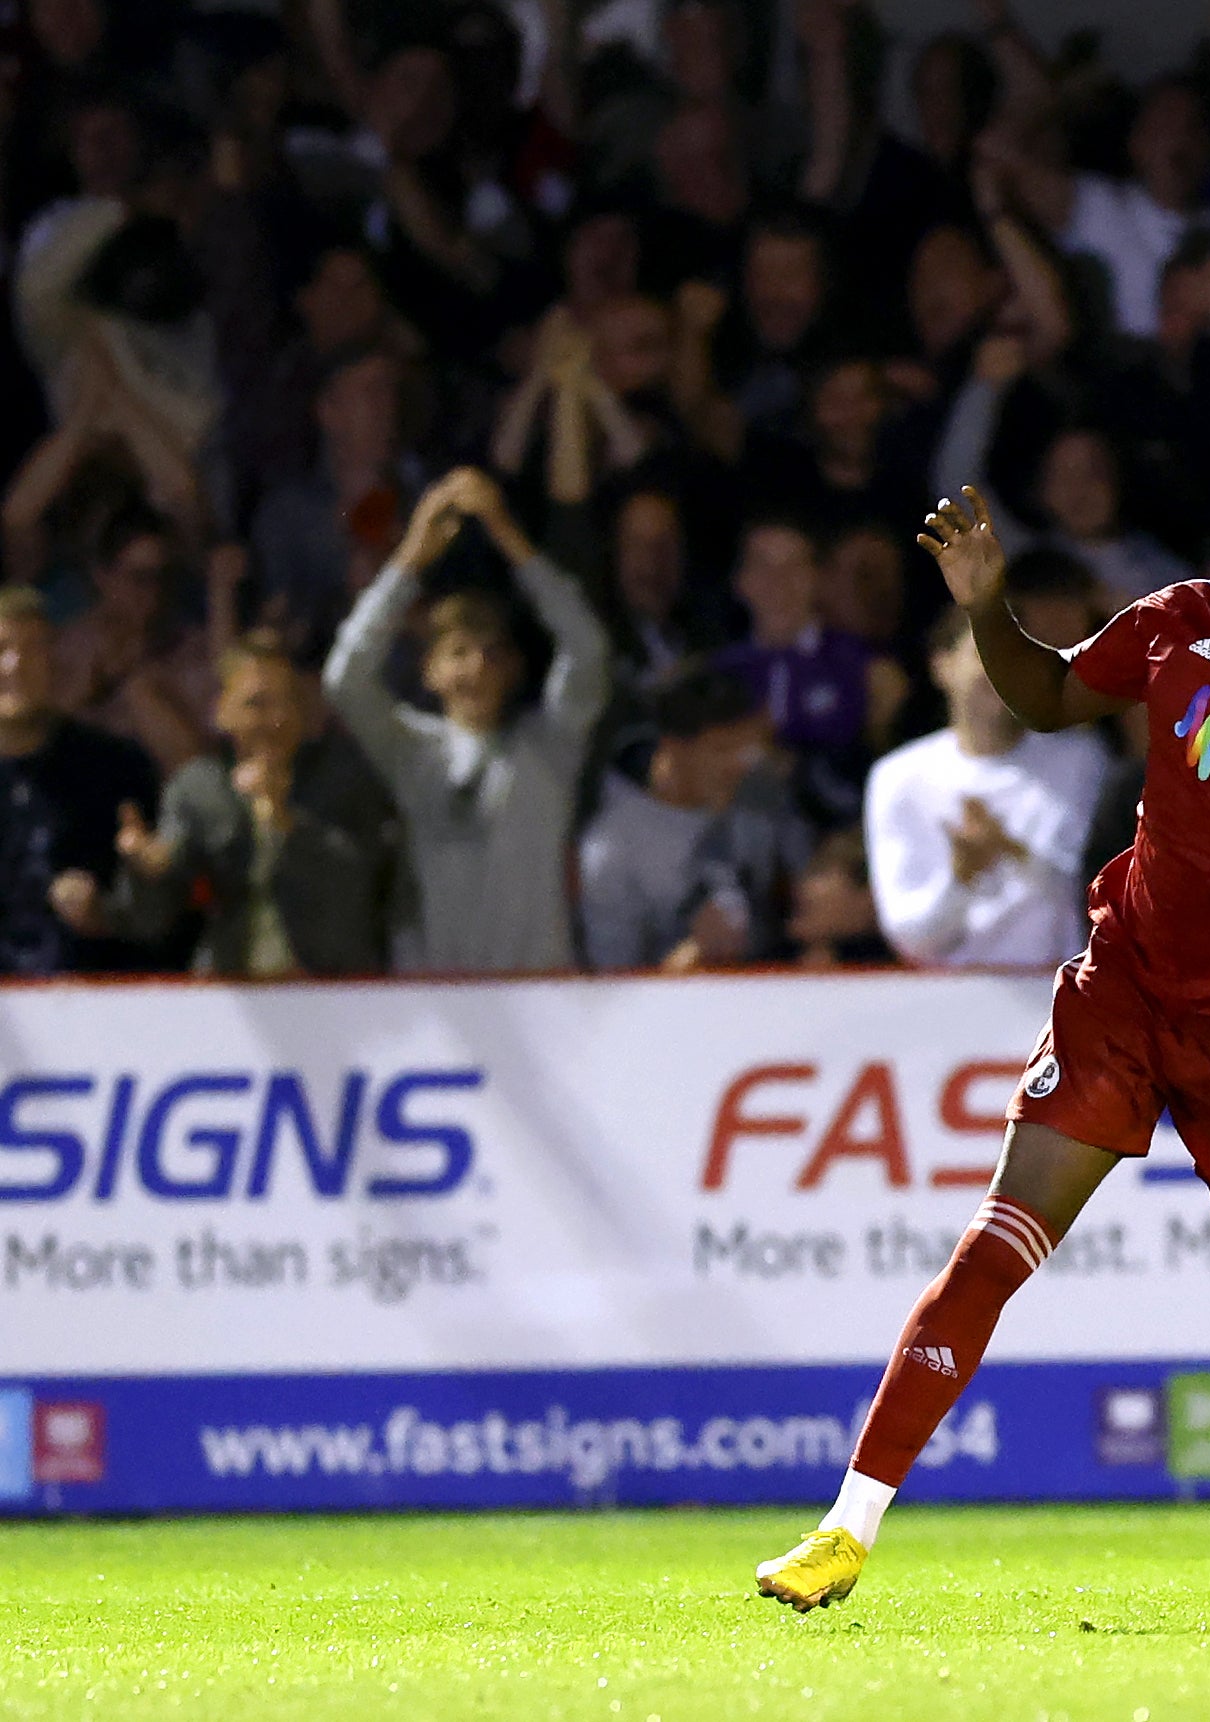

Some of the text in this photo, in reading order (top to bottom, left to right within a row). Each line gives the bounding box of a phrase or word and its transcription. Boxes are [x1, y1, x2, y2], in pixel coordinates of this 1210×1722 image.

[3, 1222, 154, 1290] More
[176, 1218, 308, 1287] than
[694, 1220, 846, 1277] More
[865, 1216, 967, 1276] tha
